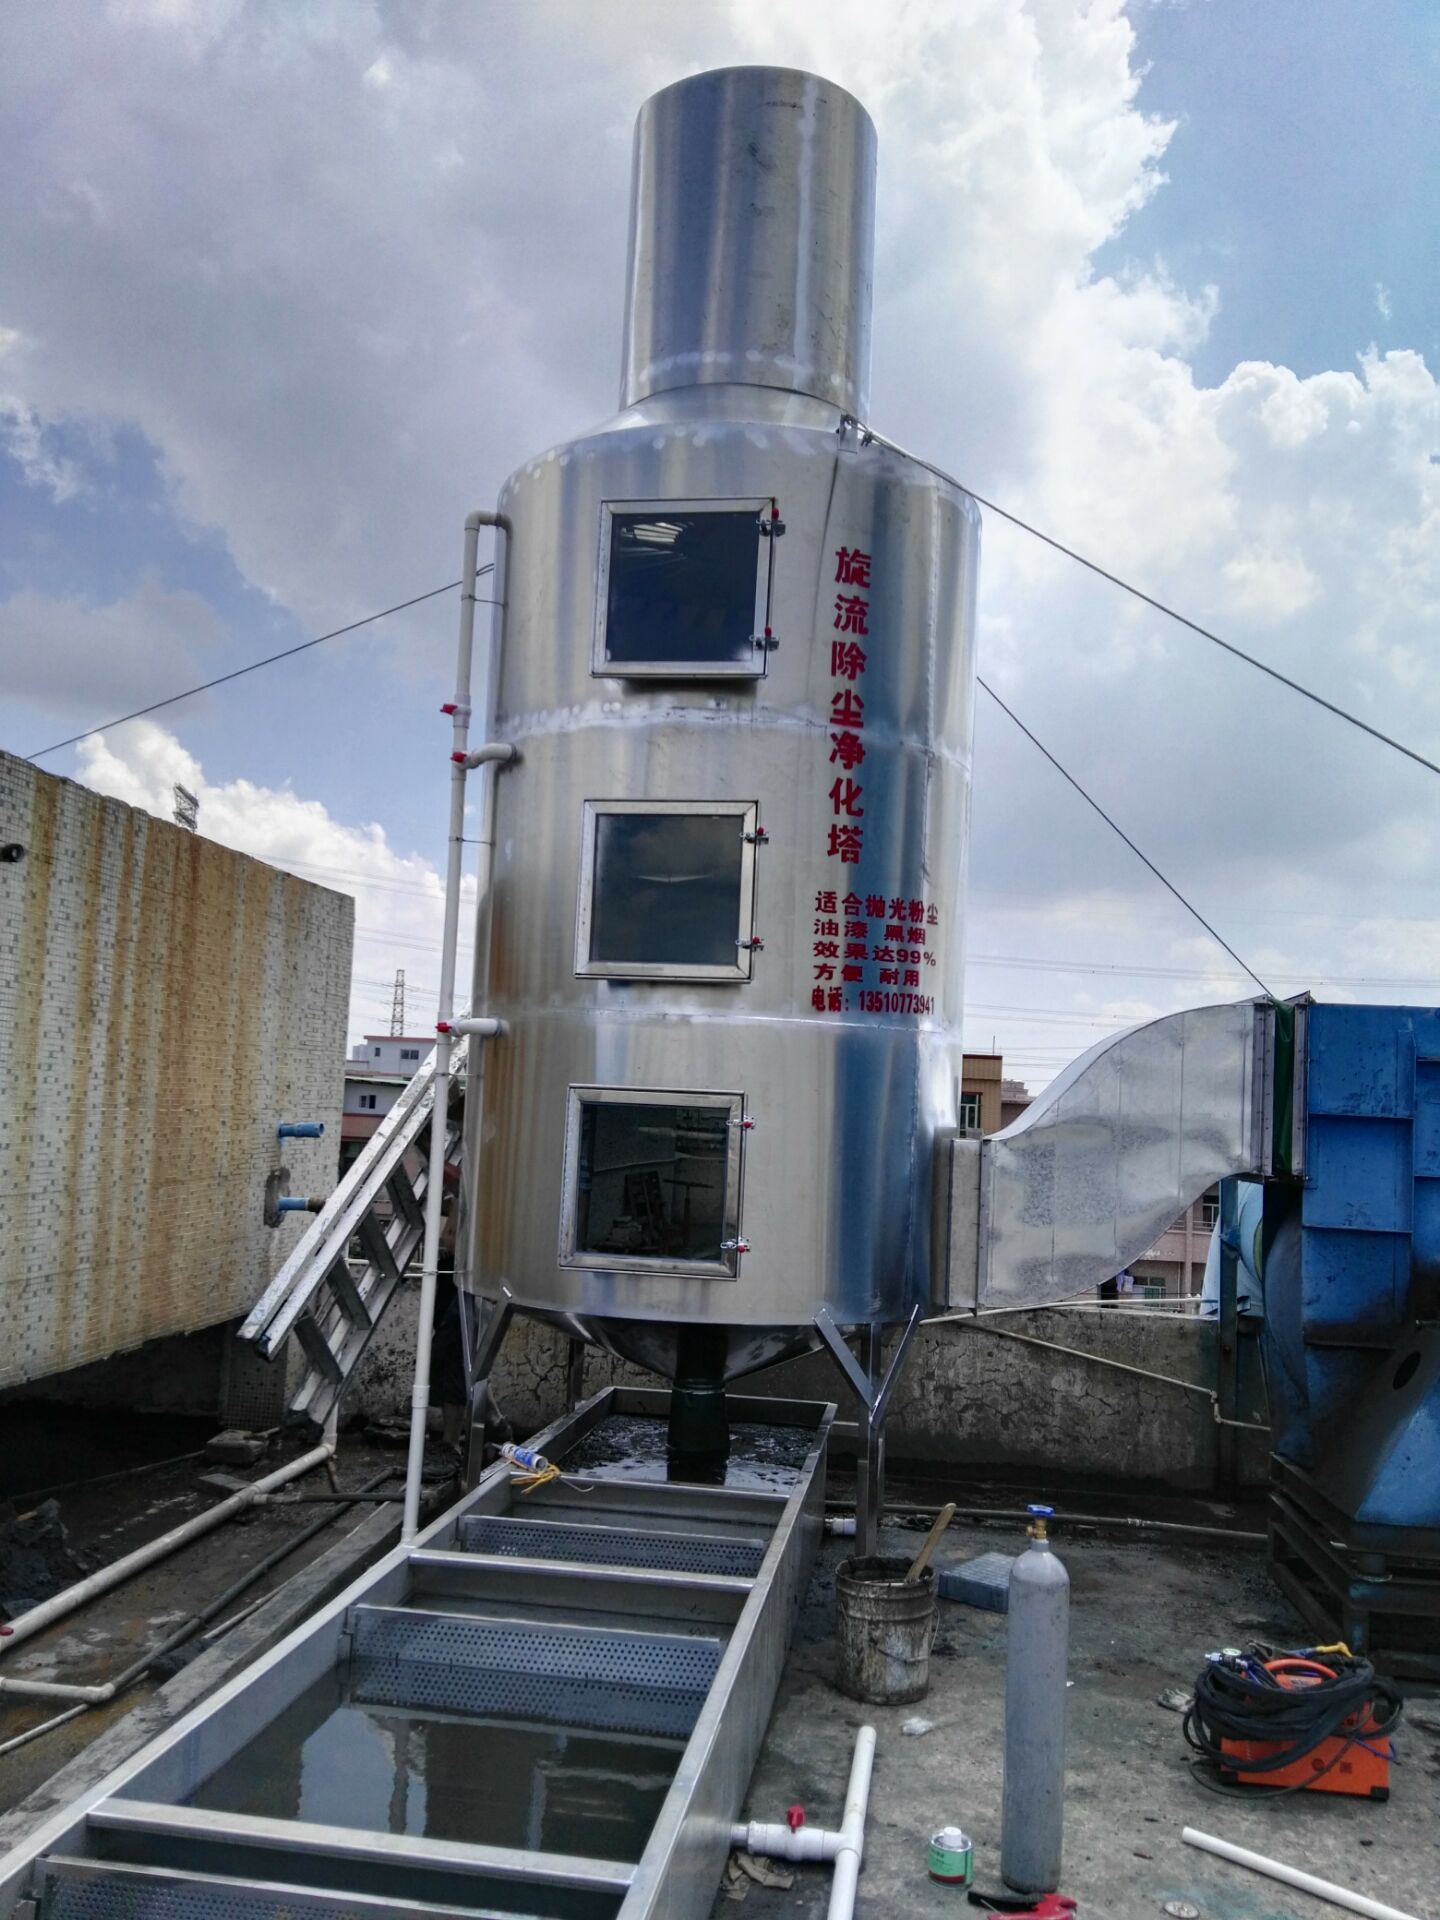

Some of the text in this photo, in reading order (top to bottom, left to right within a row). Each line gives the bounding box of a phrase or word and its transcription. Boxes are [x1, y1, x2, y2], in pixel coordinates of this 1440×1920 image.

[827, 546, 872, 864] 旋流除尘净化塔
[815, 891, 938, 926] 适合抛光粉尘
[814, 919, 868, 938] 油漆
[813, 941, 936, 966] 效果达99%
[813, 963, 919, 987] 方便 耐用
